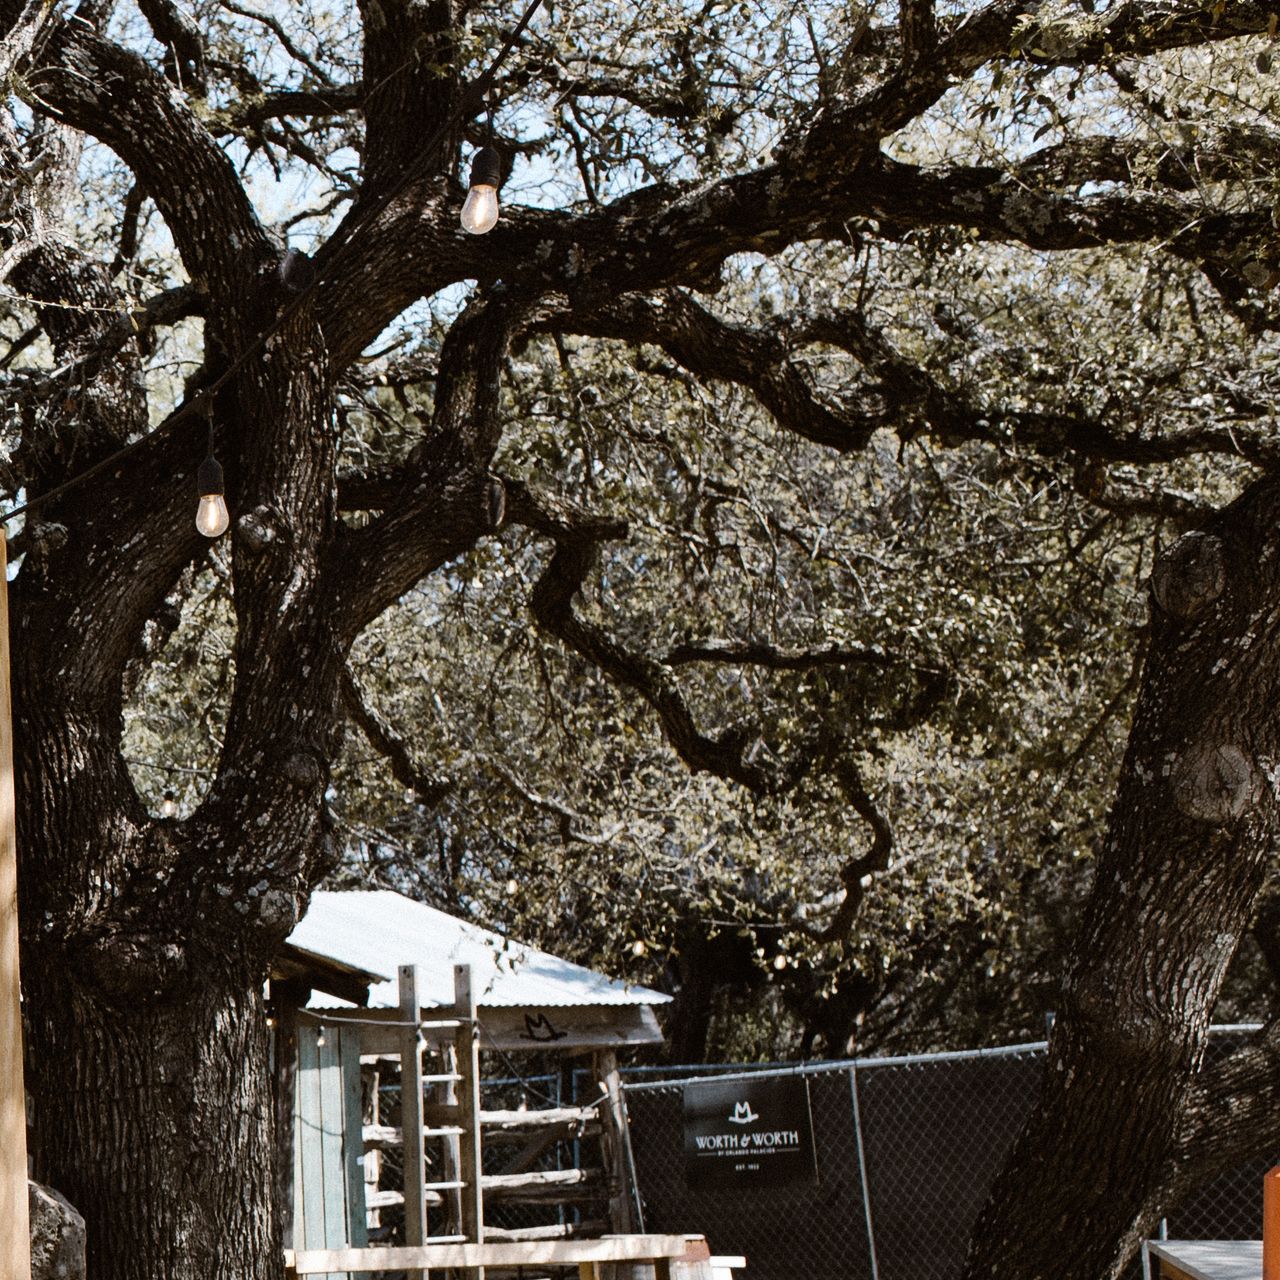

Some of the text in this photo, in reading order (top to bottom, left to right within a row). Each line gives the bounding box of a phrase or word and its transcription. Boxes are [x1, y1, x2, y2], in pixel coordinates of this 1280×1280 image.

[696, 1131, 799, 1149] WORTH & WORTH
